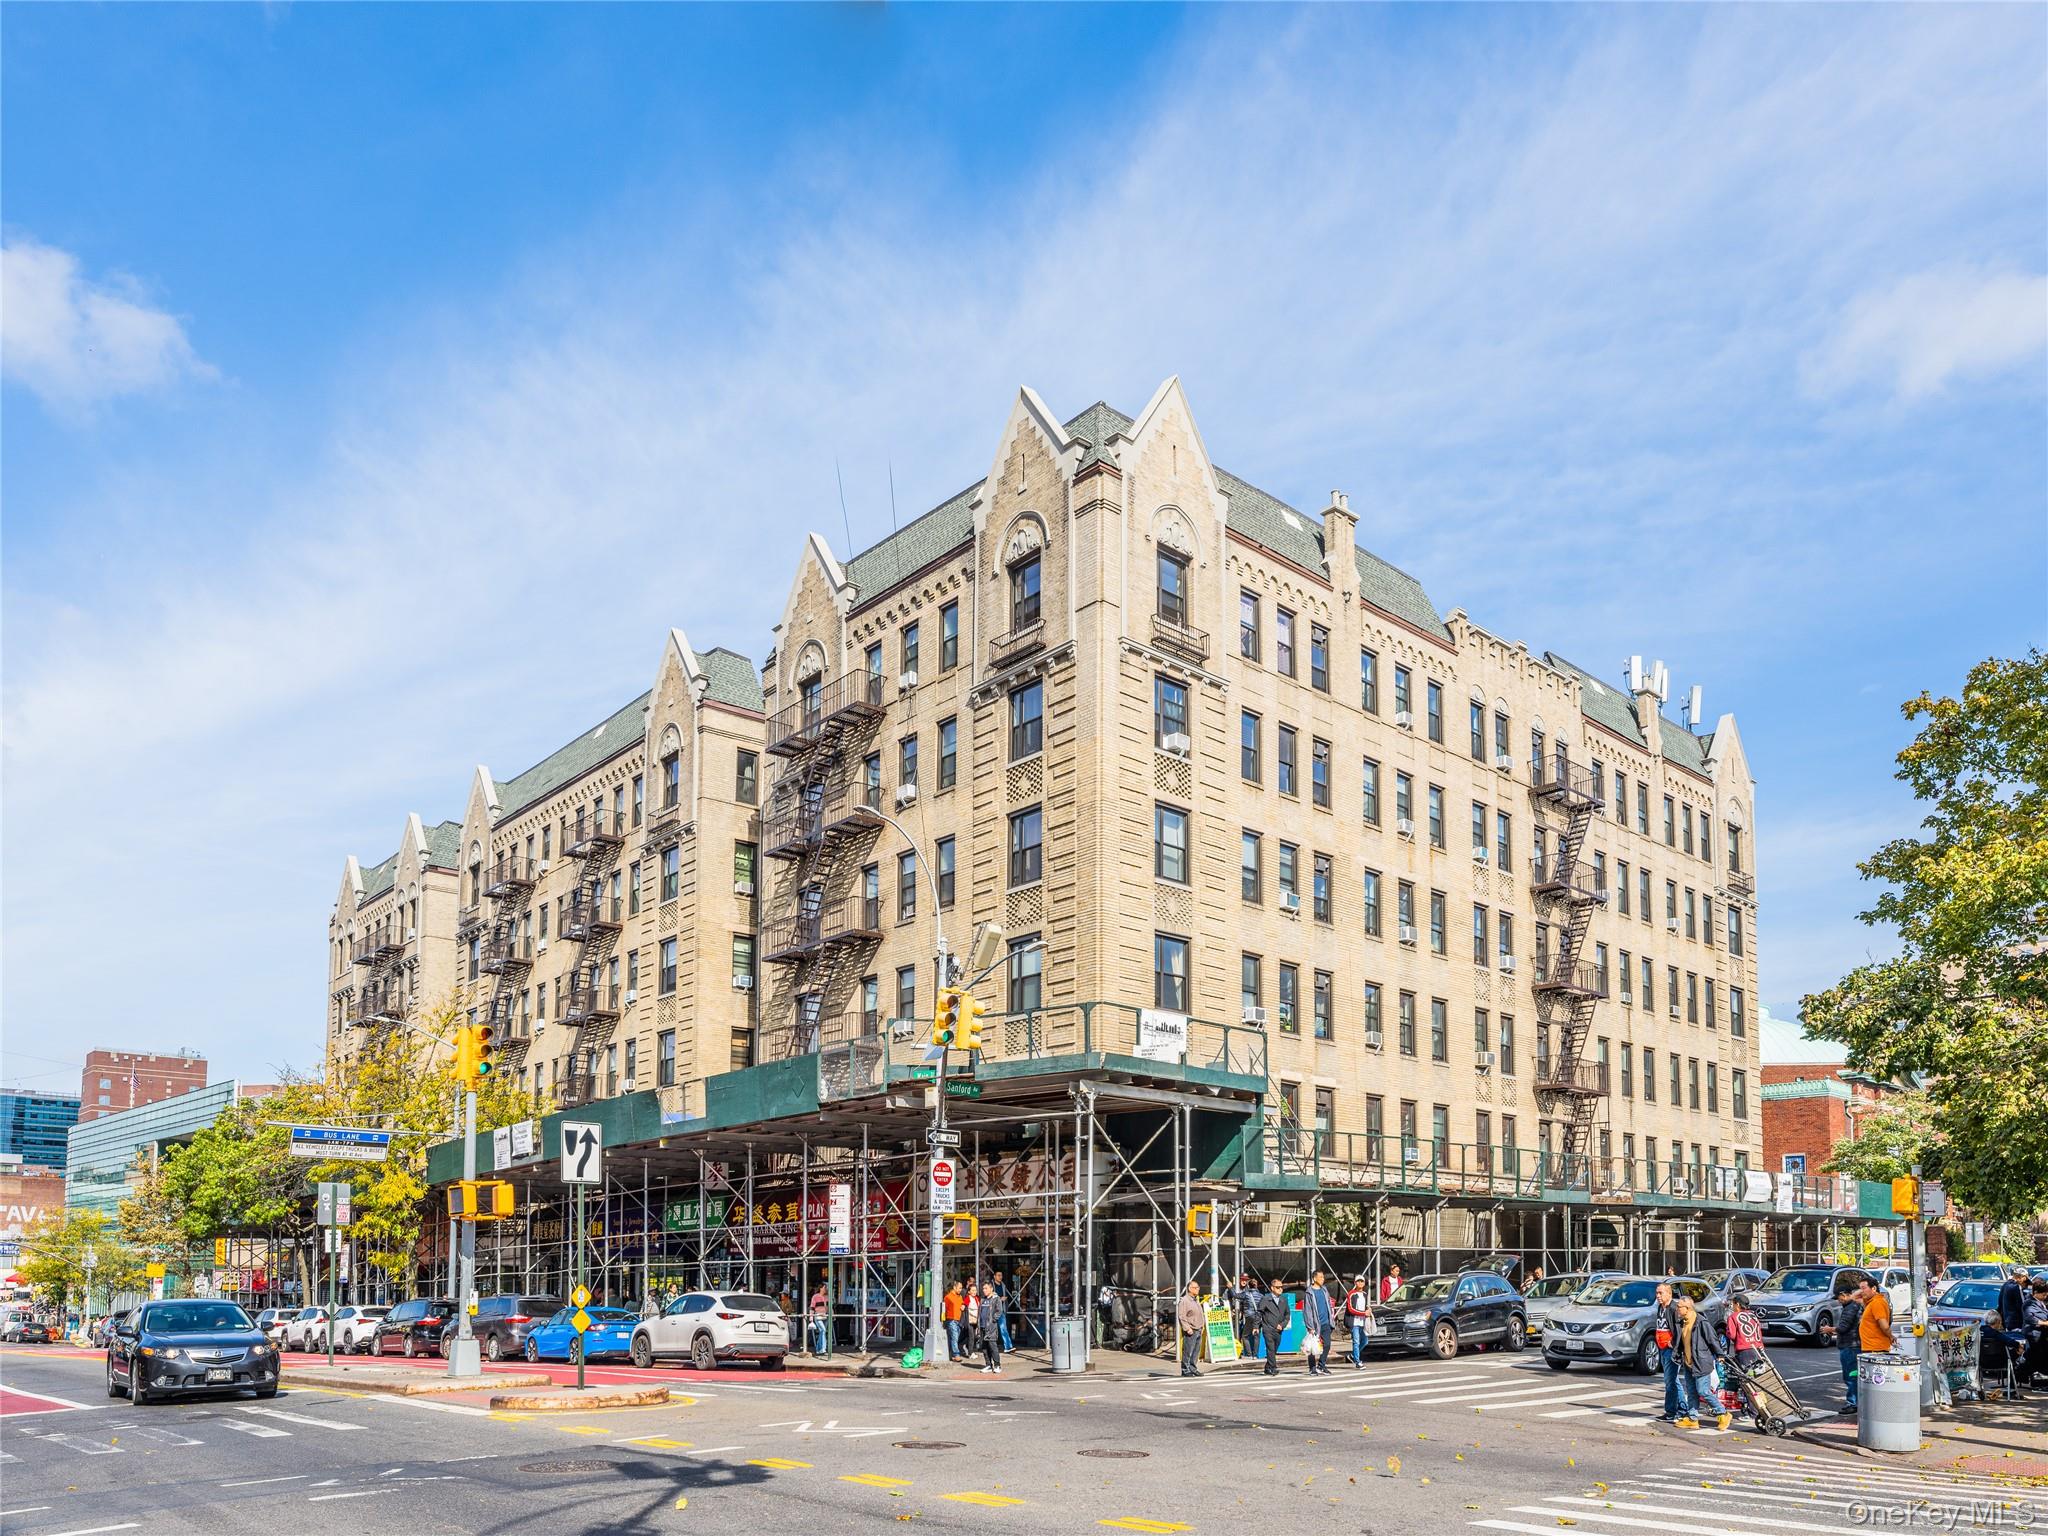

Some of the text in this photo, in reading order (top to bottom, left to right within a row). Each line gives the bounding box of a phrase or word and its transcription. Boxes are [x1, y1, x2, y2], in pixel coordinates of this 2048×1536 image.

[947, 1081, 971, 1095] Sanford
[945, 1134, 957, 1142] WAY
[807, 1203, 825, 1218] PLAY
